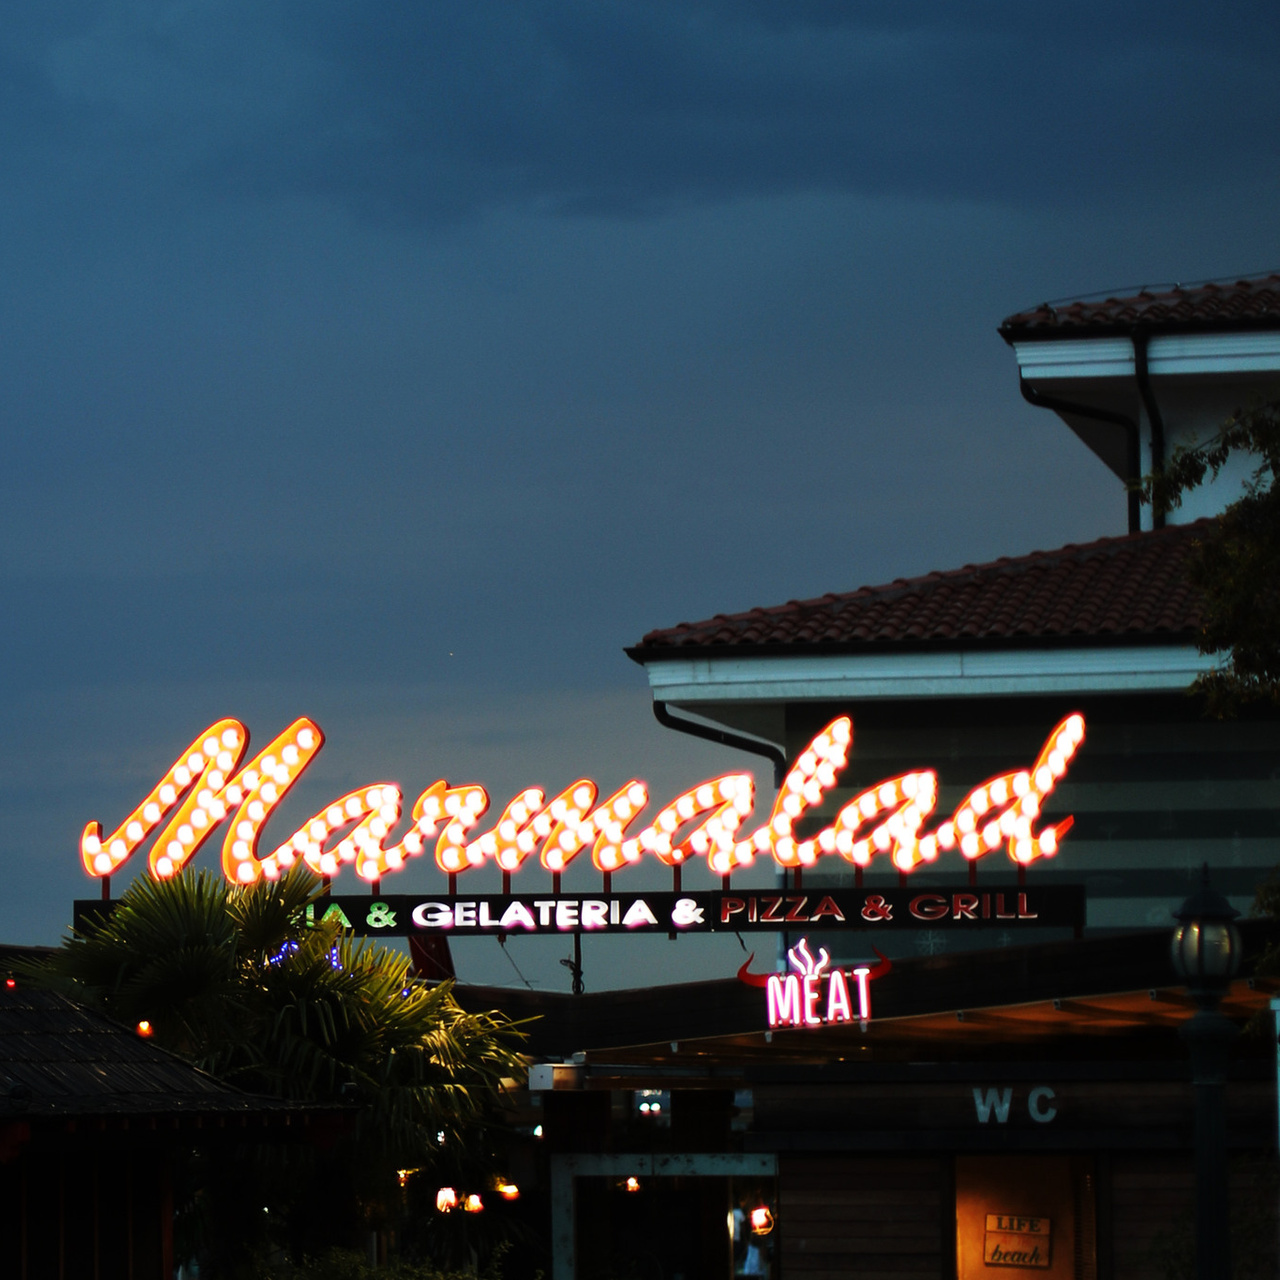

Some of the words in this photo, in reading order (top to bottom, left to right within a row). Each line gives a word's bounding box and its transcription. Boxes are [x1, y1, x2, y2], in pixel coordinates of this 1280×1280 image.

[81, 714, 1086, 886] Marmalad
[366, 901, 398, 928] &
[411, 897, 659, 931] GELATERIA
[670, 897, 706, 928] &
[721, 894, 846, 923] PIZZA
[860, 894, 893, 922] &
[909, 891, 1039, 920] GRILL
[766, 966, 872, 1027] MEAT
[996, 1216, 1042, 1233] LIFE
